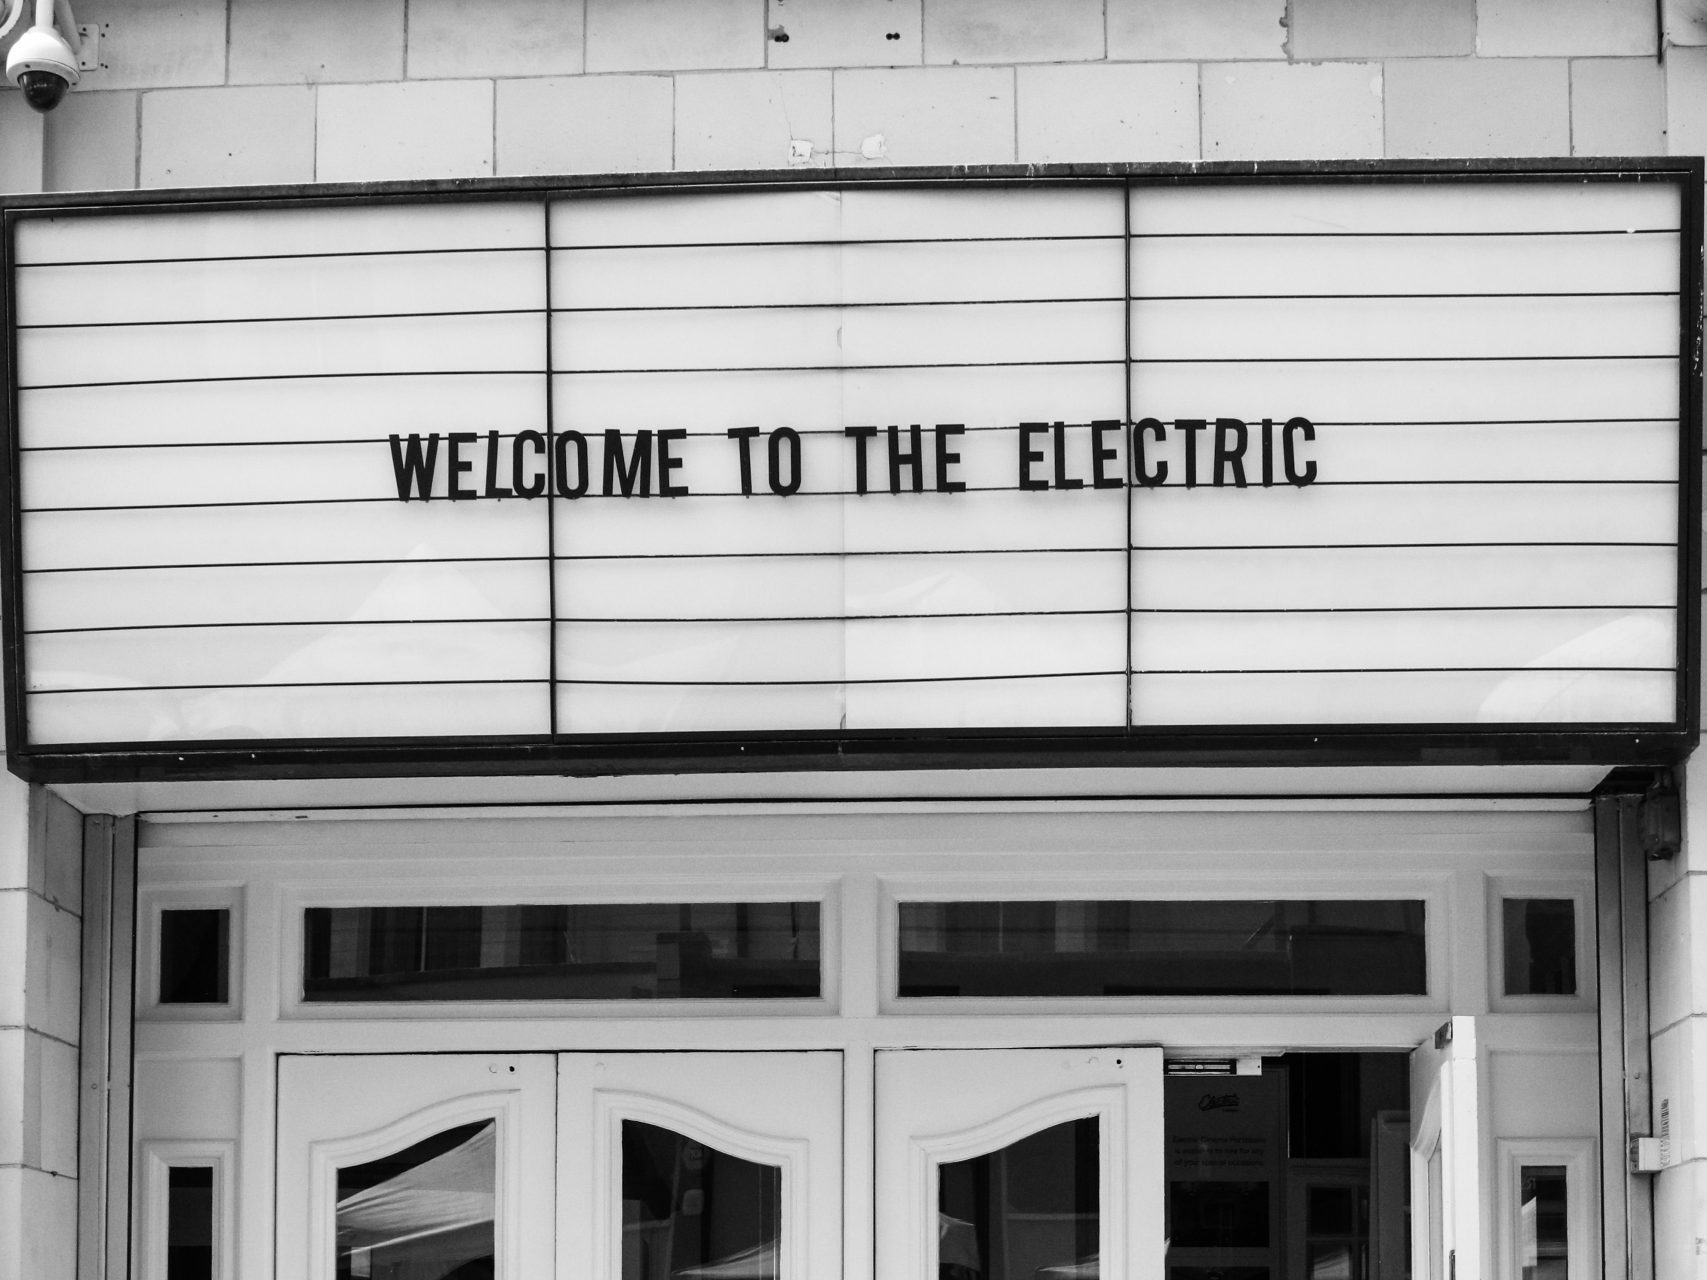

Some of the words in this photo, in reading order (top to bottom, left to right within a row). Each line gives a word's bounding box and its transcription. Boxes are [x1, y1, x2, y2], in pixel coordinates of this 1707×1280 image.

[389, 428, 689, 502] WELCOME
[727, 425, 802, 497] TO
[844, 424, 966, 495] THE
[1019, 416, 1317, 491] ELECTRIC
